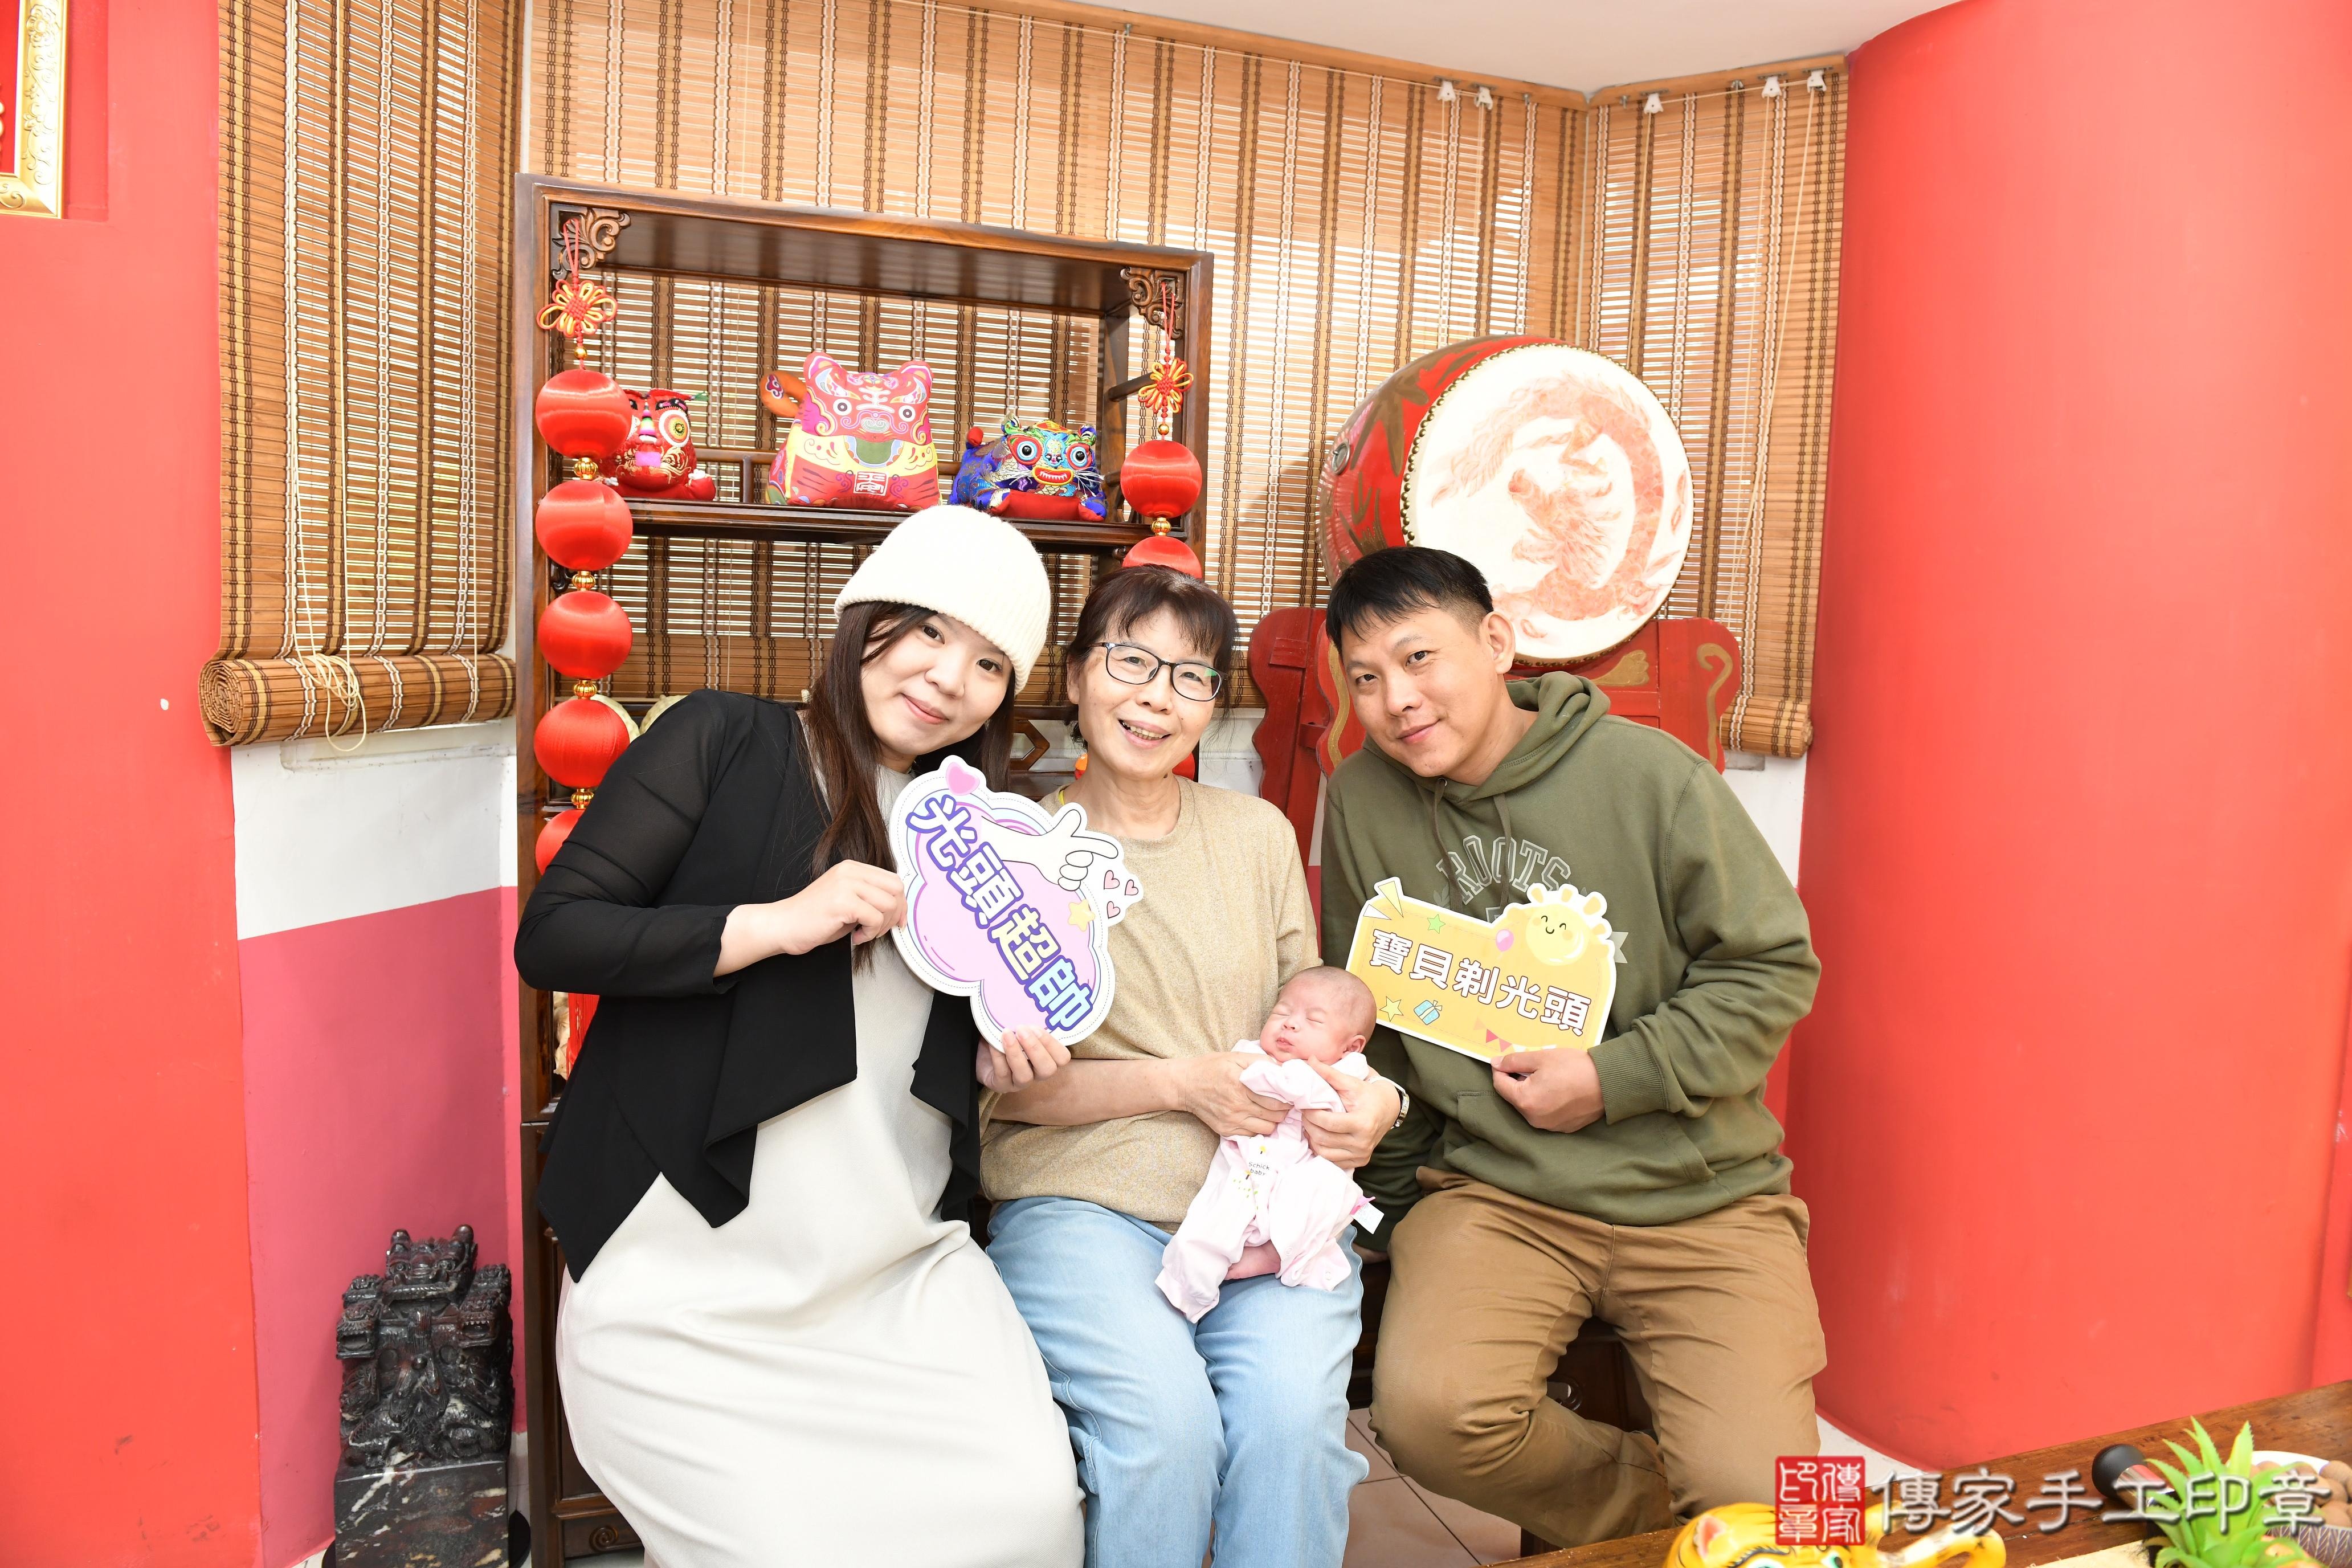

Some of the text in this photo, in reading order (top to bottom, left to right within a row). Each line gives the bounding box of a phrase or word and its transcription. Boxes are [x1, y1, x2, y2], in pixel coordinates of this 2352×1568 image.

[905, 794, 1093, 1032] 光頭超帥
[1435, 835, 1571, 905] ROOTS
[1369, 928, 1592, 1037] 寶貝剃光頭
[1248, 1161, 1270, 1170] Schick
